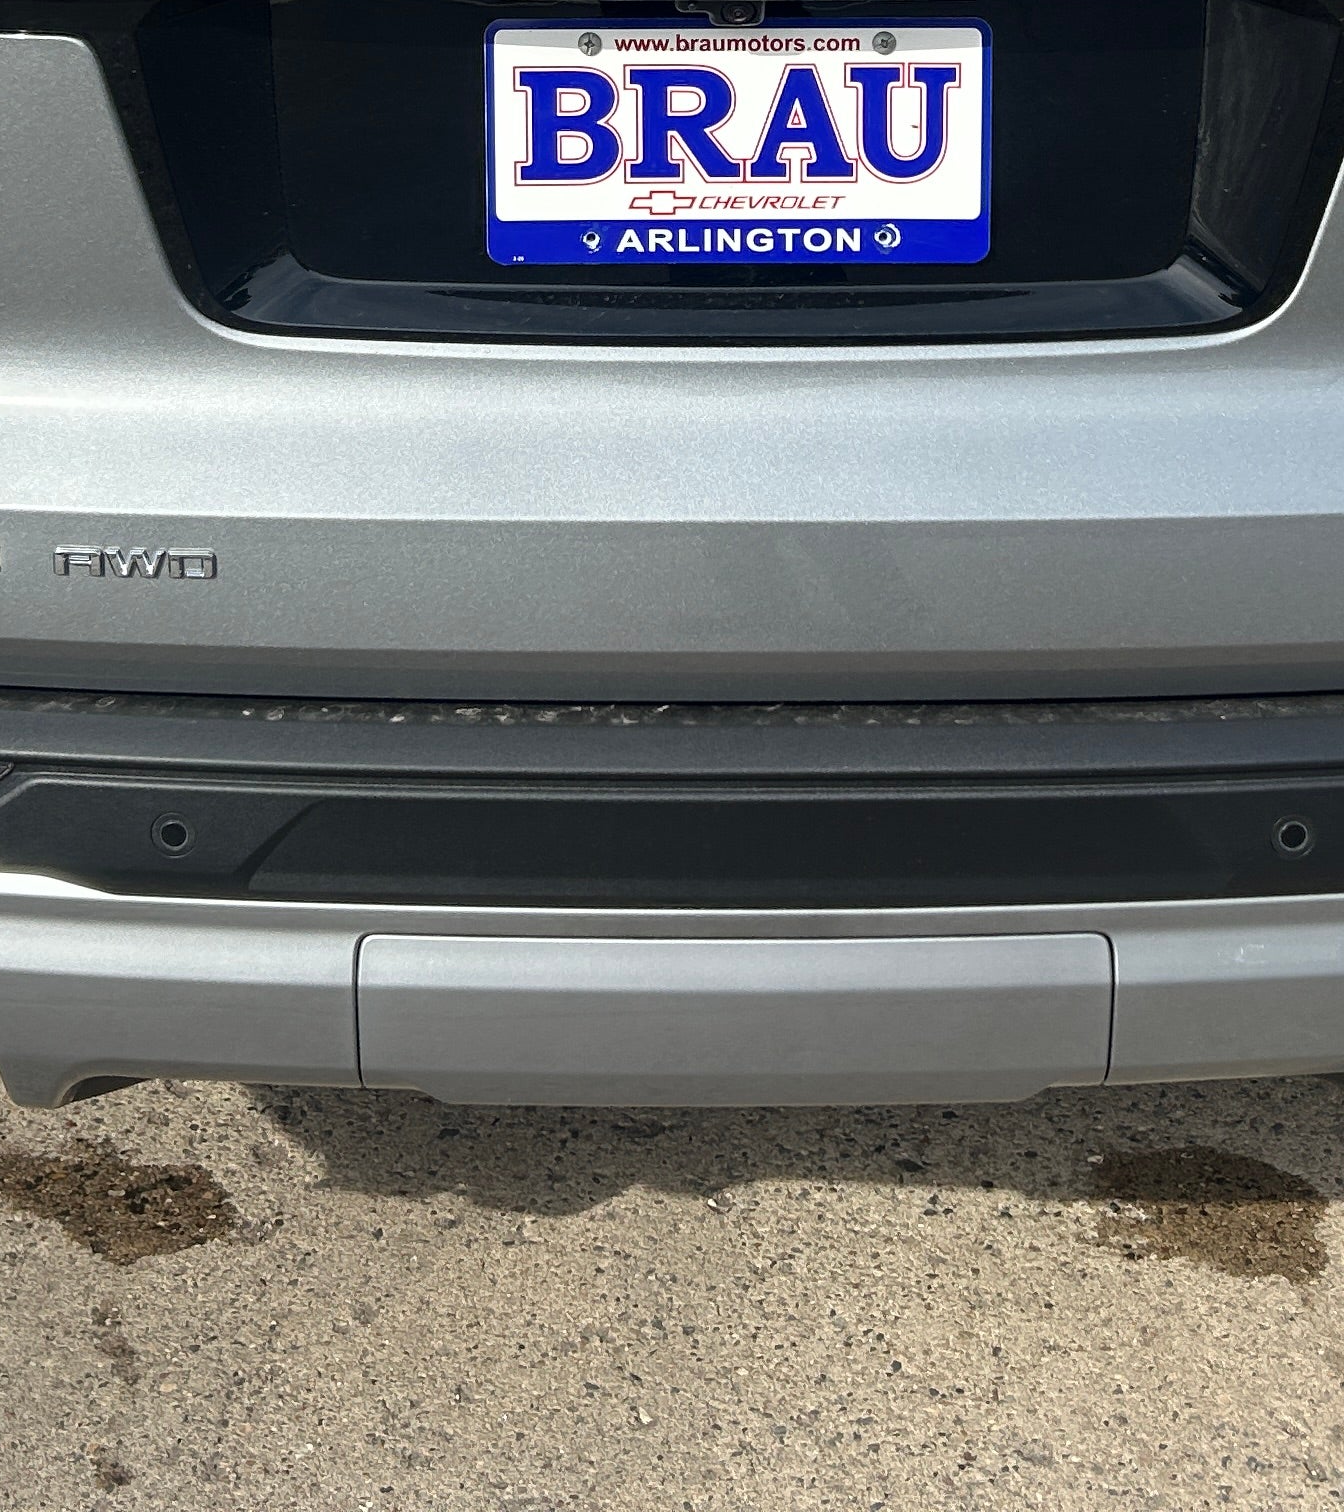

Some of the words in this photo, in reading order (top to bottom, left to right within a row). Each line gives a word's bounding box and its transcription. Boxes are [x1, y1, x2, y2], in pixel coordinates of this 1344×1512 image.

[613, 34, 861, 53] www.braumotors.com
[513, 63, 962, 186] BRAU
[698, 195, 847, 211] CHEVROLET
[616, 227, 861, 253] ARLINGTON
[52, 543, 218, 580] AWD
